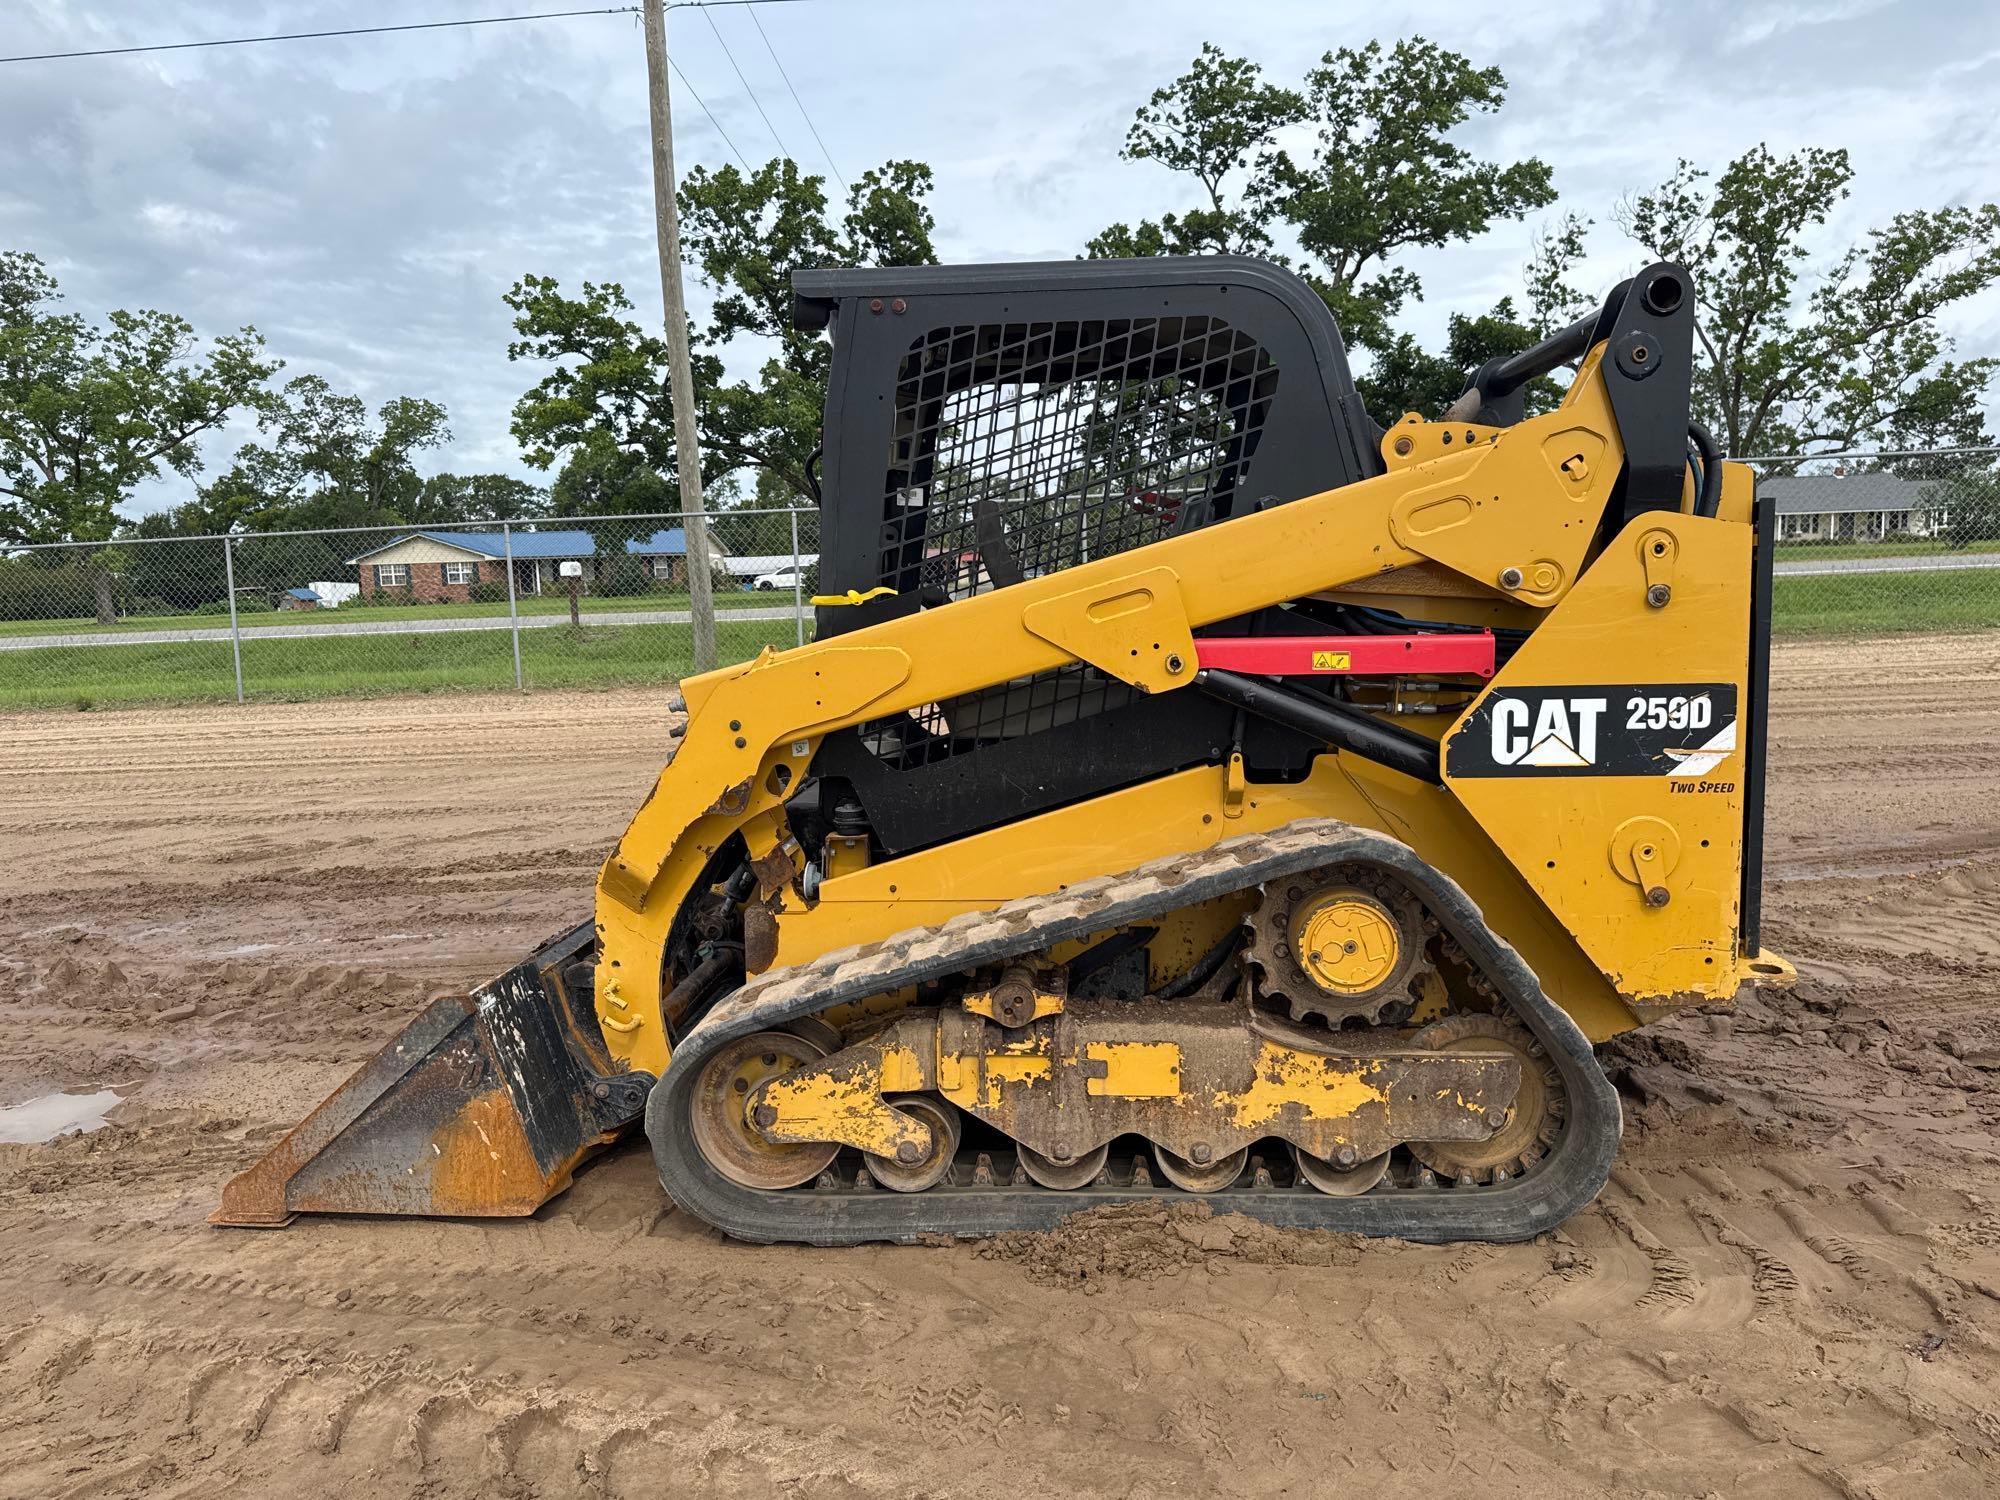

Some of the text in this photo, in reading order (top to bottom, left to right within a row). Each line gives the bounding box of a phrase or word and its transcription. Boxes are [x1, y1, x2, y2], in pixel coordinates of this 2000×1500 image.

[1626, 696, 1712, 730] 259D
[1491, 698, 1607, 766] CAT
[1670, 781, 1735, 794] TWO SPEED
